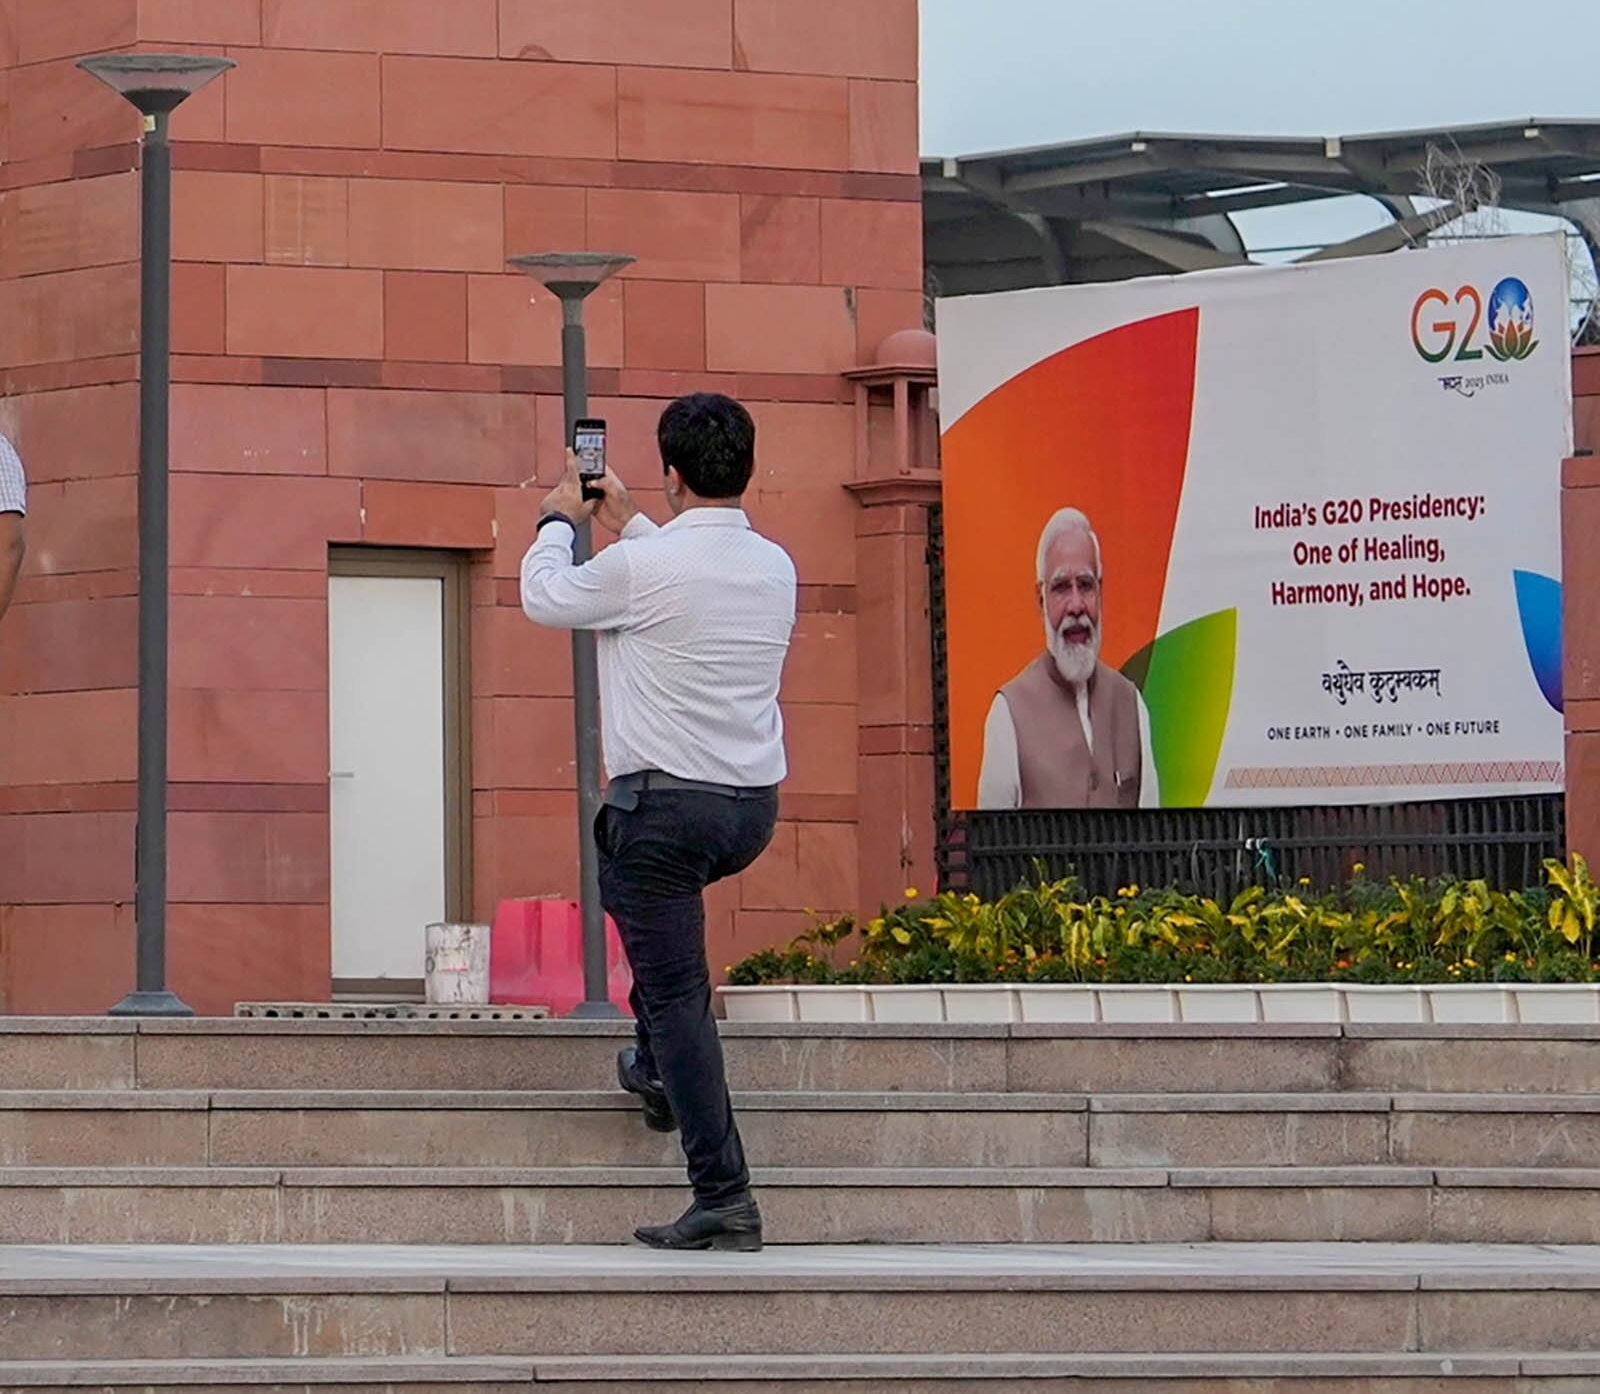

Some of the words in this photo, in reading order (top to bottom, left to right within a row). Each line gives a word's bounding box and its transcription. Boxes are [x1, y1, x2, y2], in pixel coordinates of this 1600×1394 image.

[1323, 499, 1363, 525] G20
[1369, 493, 1486, 522] Presidency:
[1293, 541, 1332, 565] One
[1338, 538, 1359, 563] of
[1364, 534, 1445, 563] Healing,
[1271, 581, 1364, 607] Harmony,
[1370, 574, 1406, 601] and
[1412, 573, 1471, 602] Hope.
[1267, 727, 1291, 741] ONE
[1294, 726, 1331, 740] EARTH
[1343, 725, 1368, 739] ONE
[1372, 723, 1413, 737] FAMILY
[1426, 722, 1451, 736] ONE
[1454, 719, 1500, 735] FUTURE
